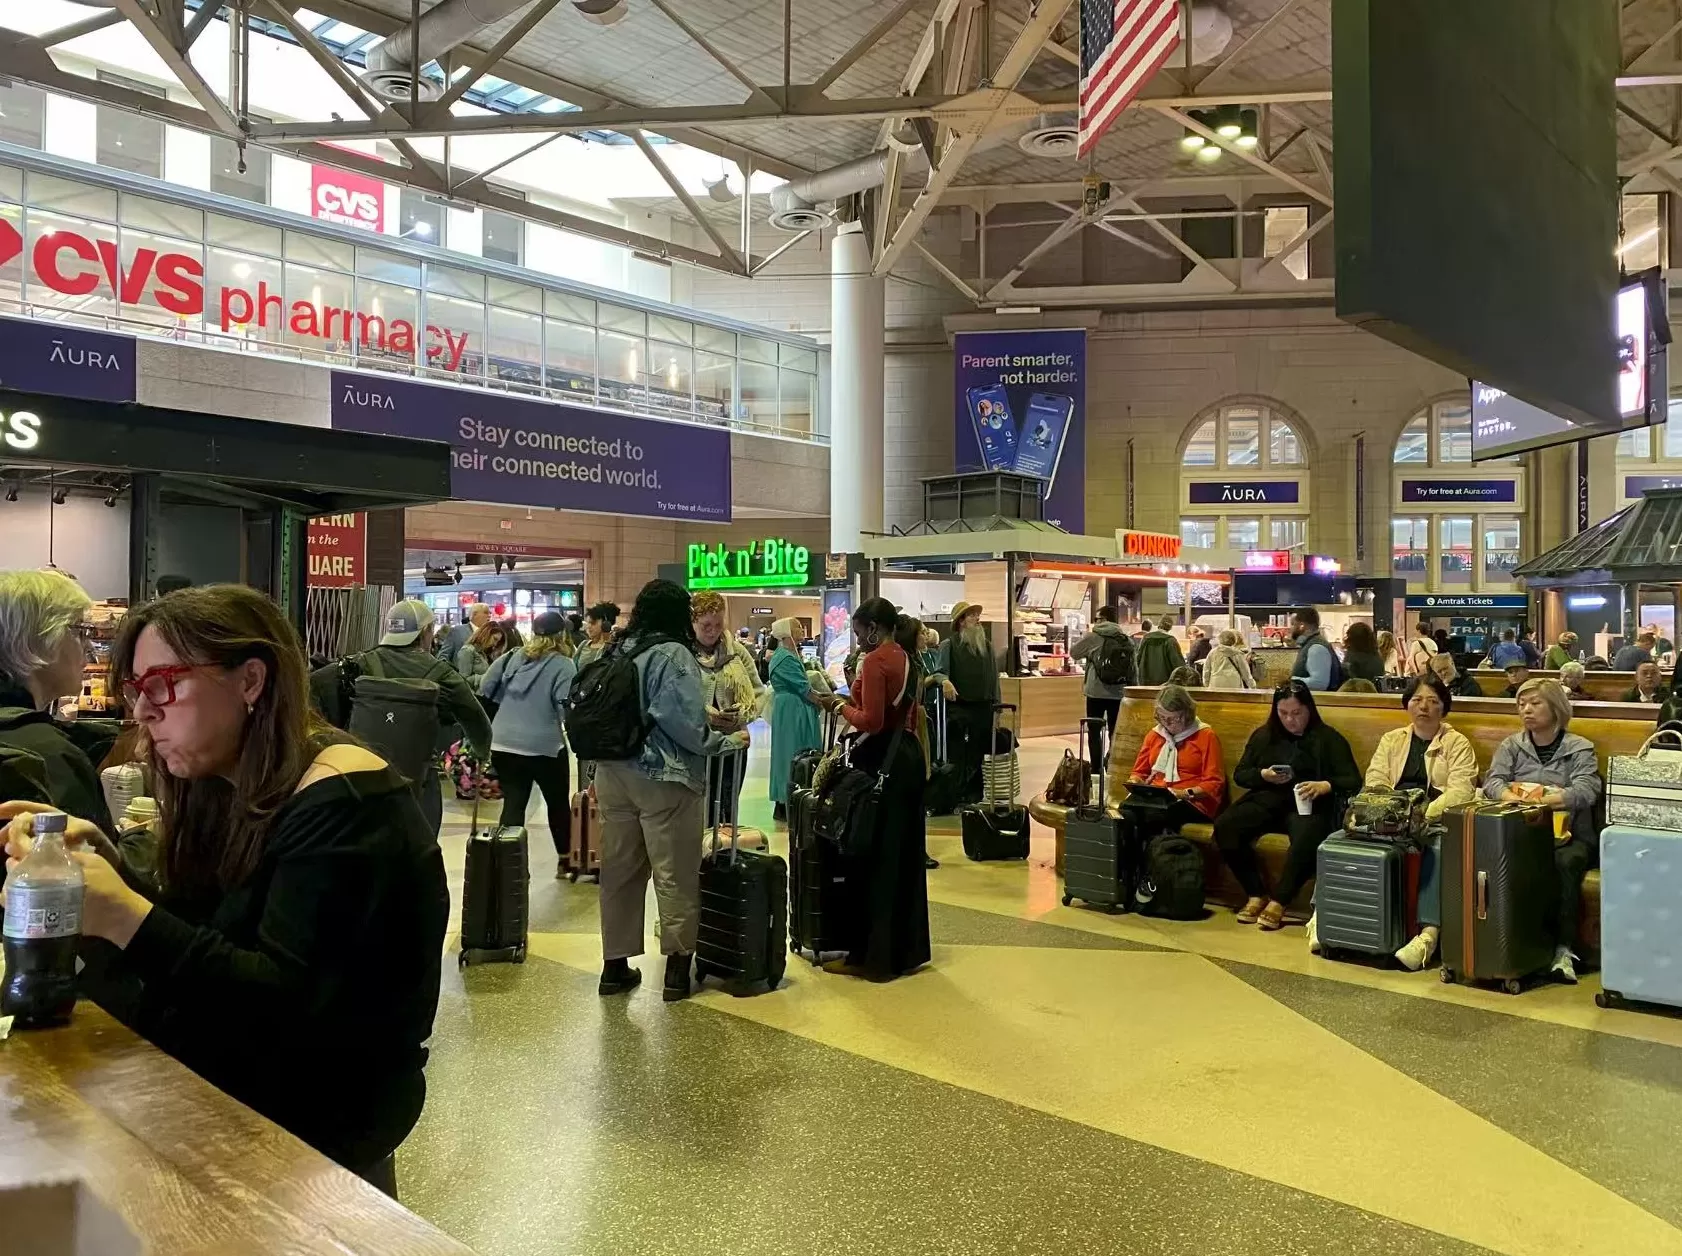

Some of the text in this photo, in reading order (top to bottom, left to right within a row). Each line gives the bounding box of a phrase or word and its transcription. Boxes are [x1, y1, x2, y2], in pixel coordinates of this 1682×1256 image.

[317, 183, 379, 221] CVS
[33, 231, 469, 371] CVS pharmacy
[962, 352, 1074, 369] Parent smarter,
[999, 369, 1078, 384] not harder.
[0, 411, 42, 449] S
[459, 417, 643, 461] Stay connected to
[492, 456, 602, 483] connected
[606, 467, 662, 490] world.
[1416, 487, 1498, 496] Try for free at Aura.com
[657, 501, 724, 514] Try for free at Aura.com
[319, 534, 339, 545] the
[475, 543, 528, 553] DEWEY SQUARE
[688, 538, 809, 578] Pick n' Bite
[1436, 597, 1494, 605] Amtrak Tickets
